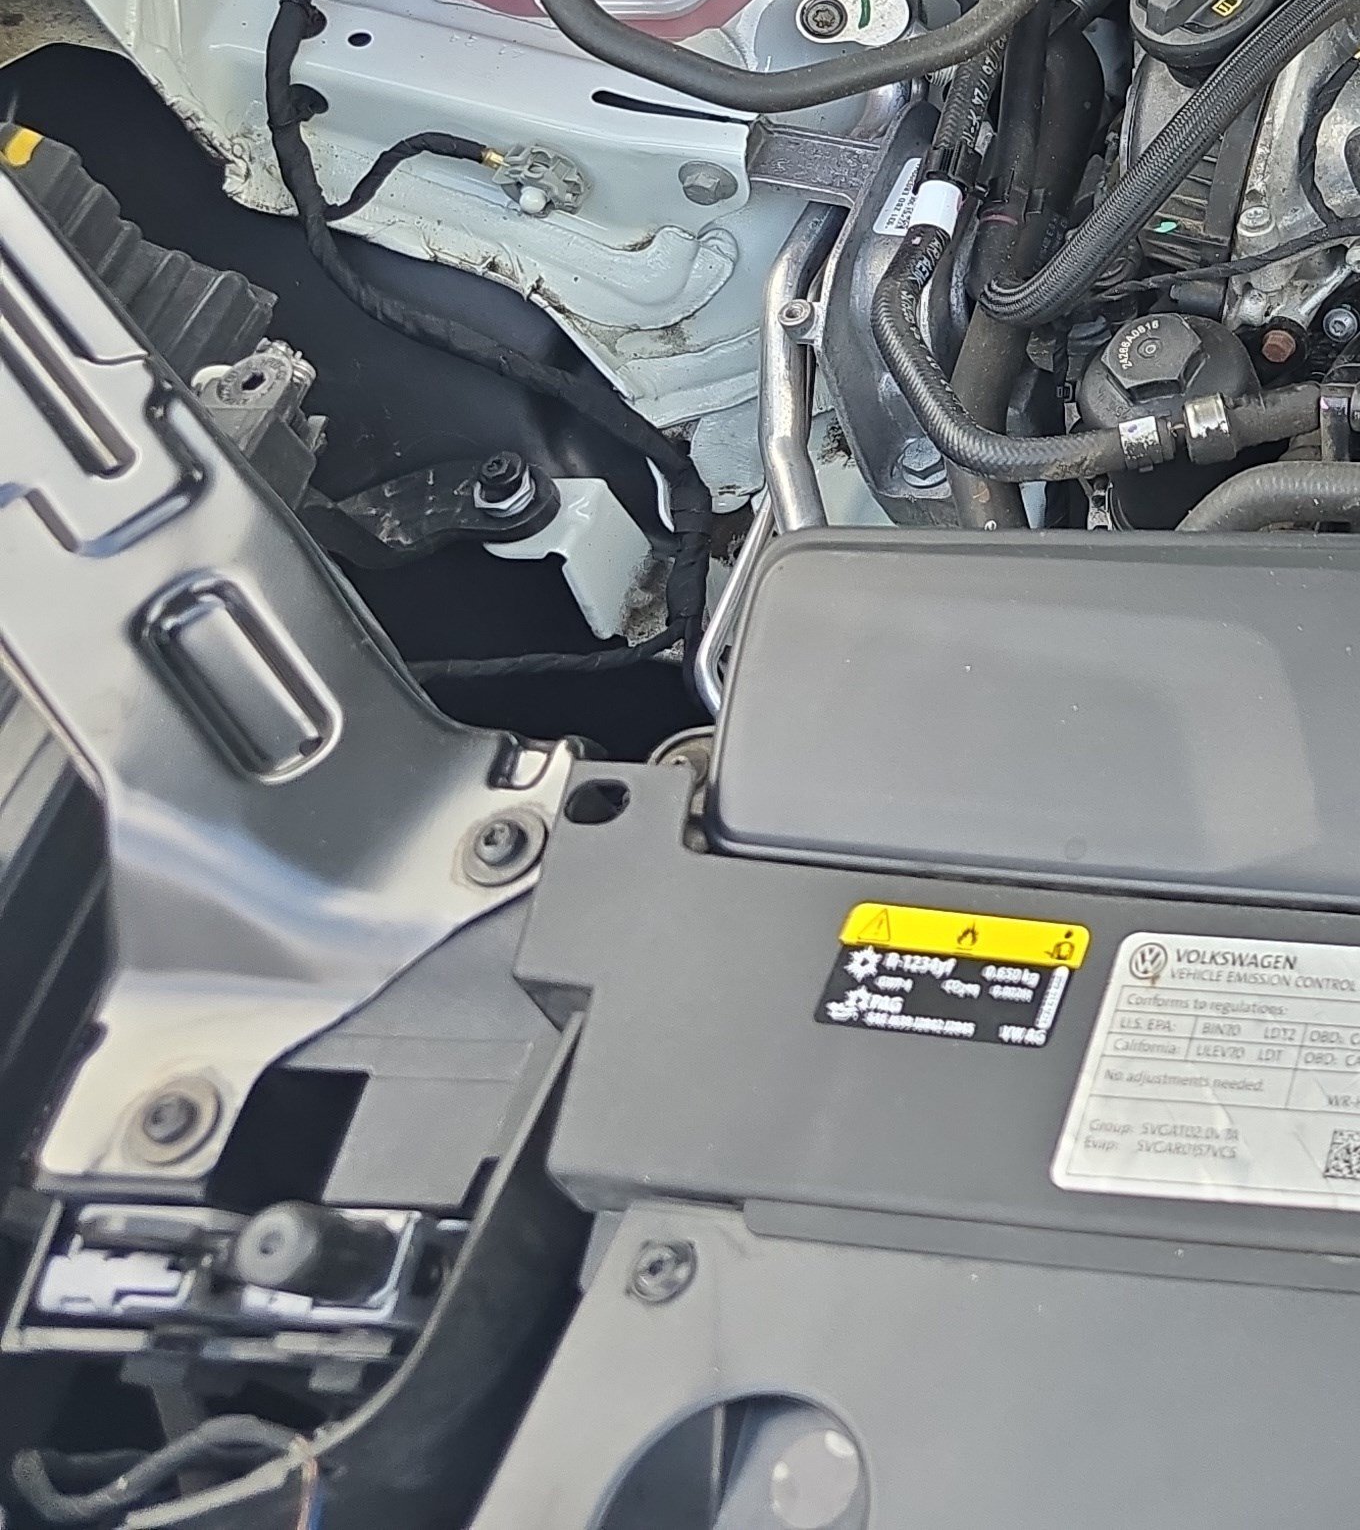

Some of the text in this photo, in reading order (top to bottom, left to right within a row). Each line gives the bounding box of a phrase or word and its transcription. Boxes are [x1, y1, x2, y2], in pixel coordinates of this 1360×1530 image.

[1176, 949, 1296, 970] VOLKSWAGEN
[1170, 968, 1222, 982] VEHICLE
[1226, 971, 1290, 986] EMISSION
[1294, 975, 1356, 992] CONTROL
[870, 993, 904, 1014] PAG
[1126, 993, 1189, 1009] Conforms
[1192, 998, 1208, 1010] to
[1104, 1069, 1124, 1081] No
[1126, 1072, 1210, 1087] adjustments
